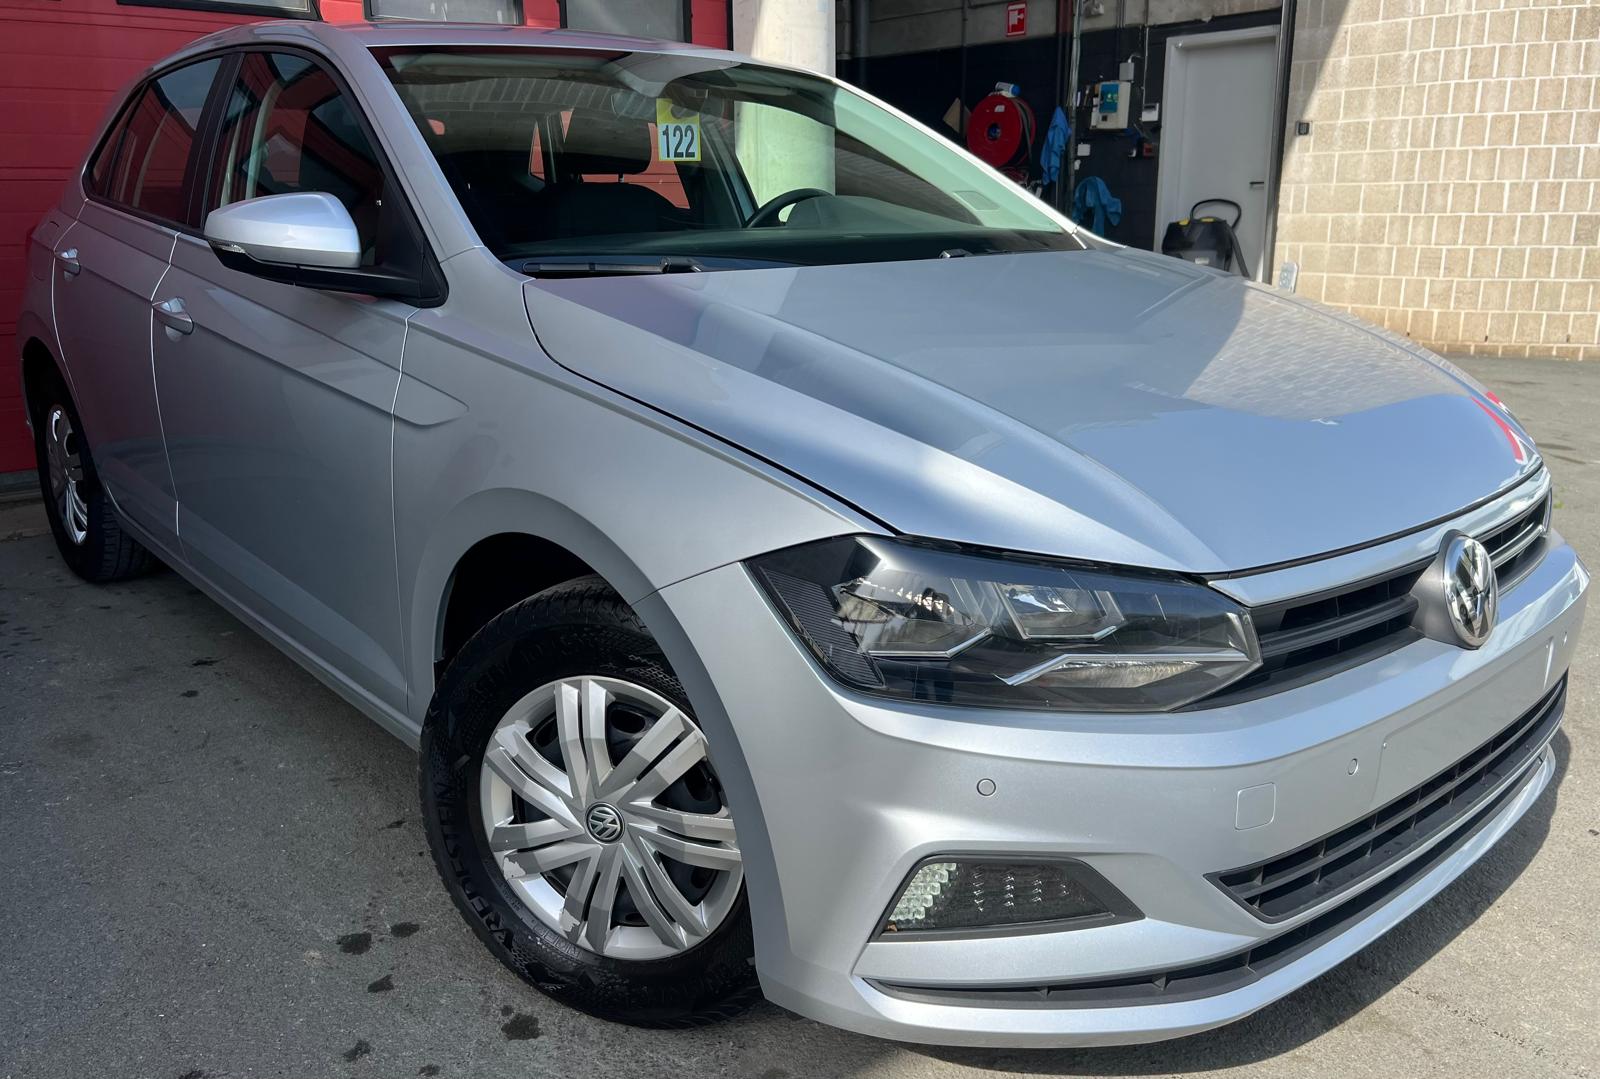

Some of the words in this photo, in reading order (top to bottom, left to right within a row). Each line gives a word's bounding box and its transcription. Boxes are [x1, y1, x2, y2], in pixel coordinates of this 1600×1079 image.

[662, 125, 696, 158] 122
[588, 805, 622, 842] VW
[432, 780, 515, 950] VREDESTEIN
